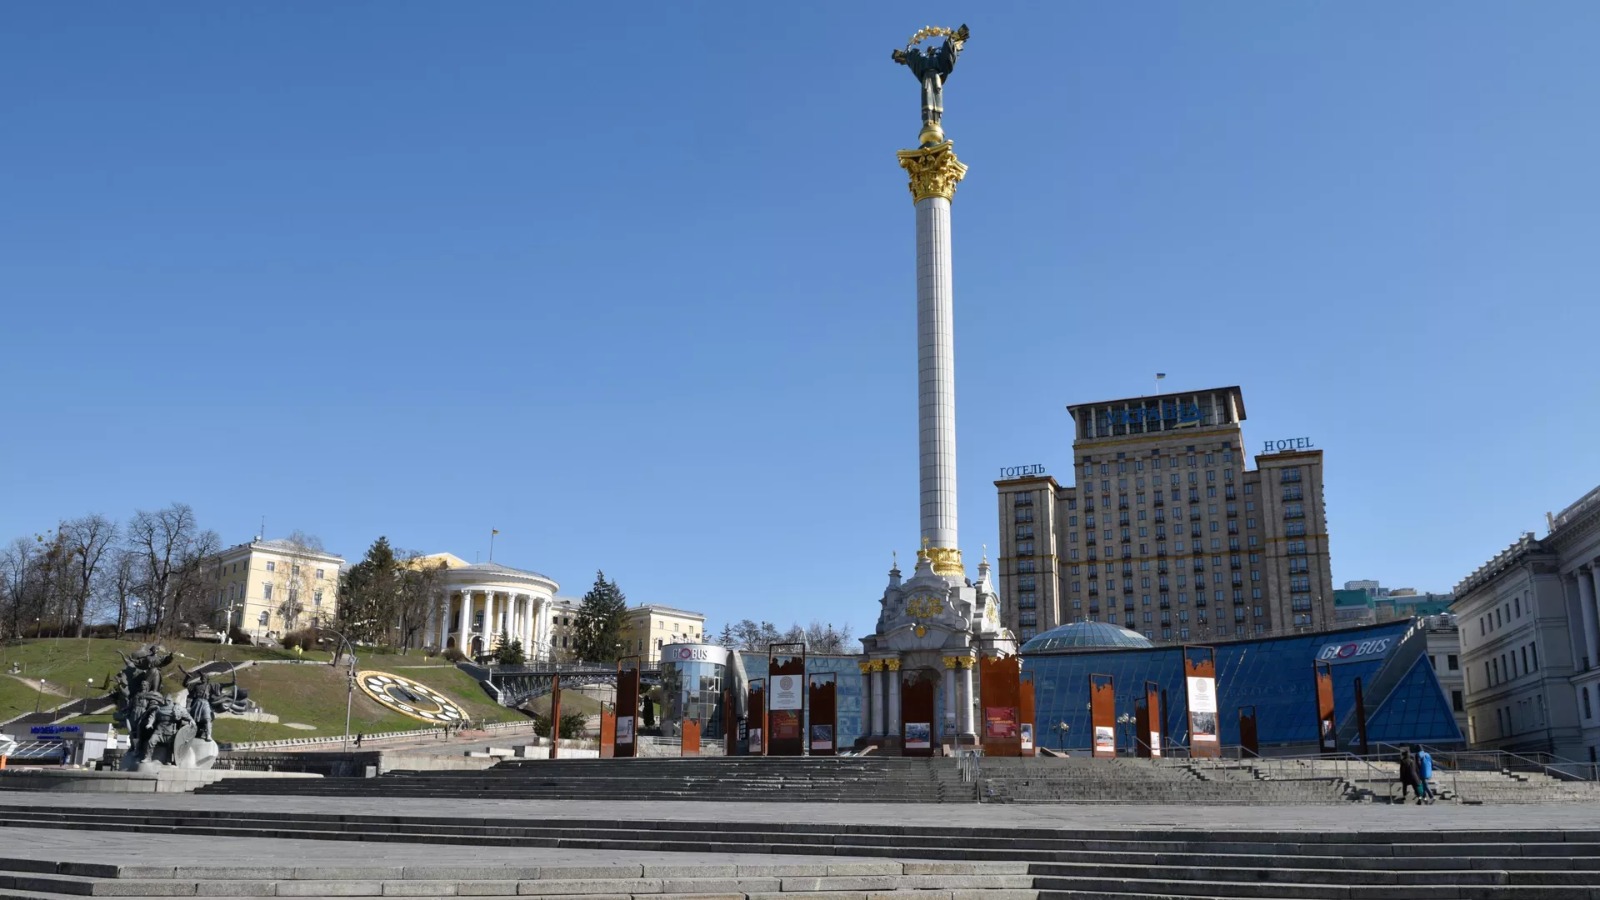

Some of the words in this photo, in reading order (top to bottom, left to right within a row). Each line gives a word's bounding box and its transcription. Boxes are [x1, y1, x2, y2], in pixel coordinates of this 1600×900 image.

[1264, 437, 1314, 451] HOTEL
[1000, 464, 1046, 477] ГОТЕЛЬ
[672, 648, 708, 660] GLOBUS
[1321, 638, 1390, 660] GLOBUS
